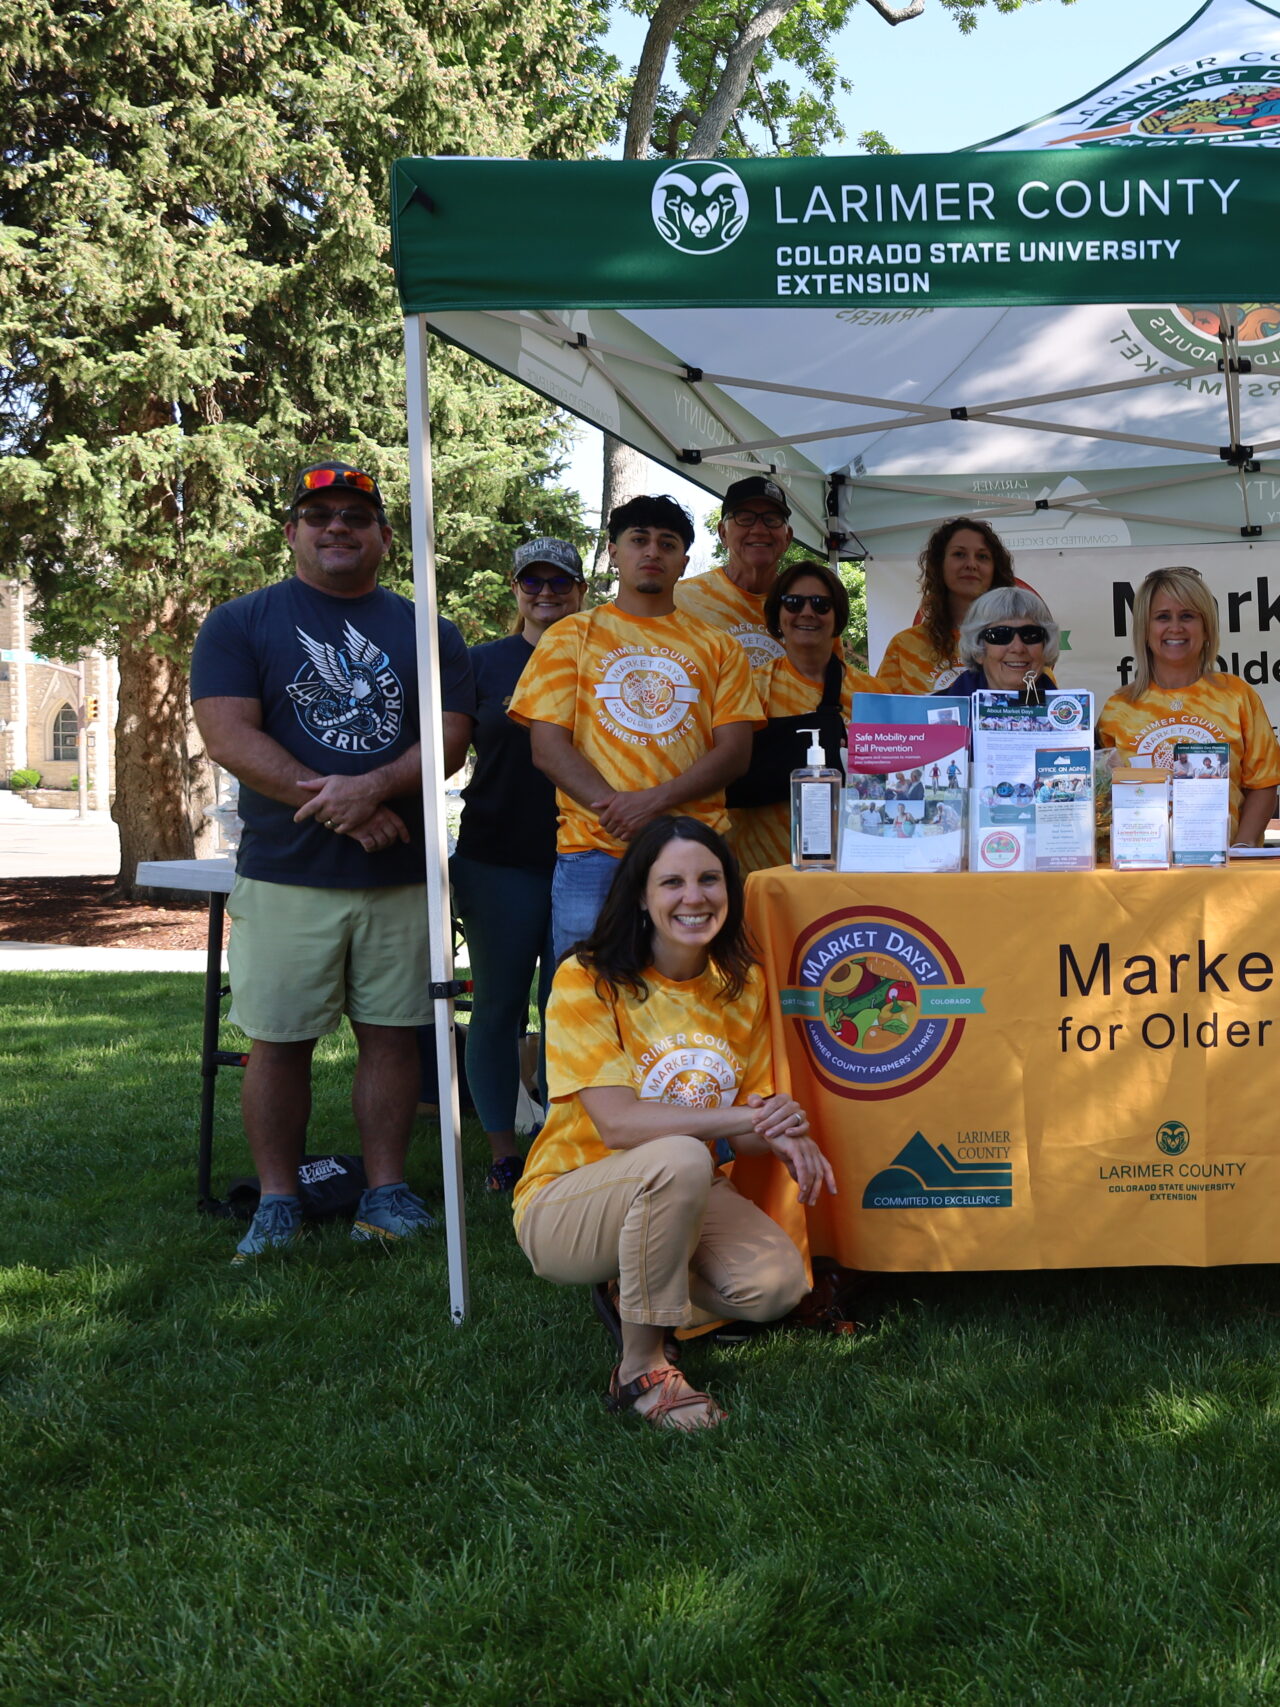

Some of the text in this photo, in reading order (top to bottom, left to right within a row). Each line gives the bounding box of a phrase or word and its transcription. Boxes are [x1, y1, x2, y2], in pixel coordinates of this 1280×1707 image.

[1059, 56, 1217, 126] LARIMER
[1106, 69, 1248, 124] MARKET
[775, 177, 1242, 225] LARIMER COUNTY
[776, 238, 1182, 267] COLORADO STATE UNIVERSITY
[776, 271, 931, 296] EXTENSION
[595, 645, 700, 677] LARIMER COUNTY
[611, 659, 684, 682] MARKET DAYS
[321, 672, 400, 750] ERIC CHURCH
[612, 703, 626, 718] FOR
[656, 707, 682, 729] ADULTS
[595, 710, 697, 747] FARMERS' MARKET
[855, 732, 925, 744] Safe Mobility and
[1128, 715, 1226, 747] LARIMER COUNTY
[1143, 727, 1212, 751] MARKET DAYS
[855, 744, 913, 753] Fall Prevention
[802, 930, 939, 983] MARKET DAYS!
[930, 998, 971, 1006] COLORADO
[1058, 1017, 1123, 1053] for
[1141, 1012, 1273, 1050] Older
[633, 1032, 744, 1084] LARIMER COUNTY
[808, 1022, 936, 1074] LARIMER COUNTY FARMERS' MARKET
[648, 1054, 732, 1093] MARKET DAYS
[957, 1131, 1011, 1145] LARIMER
[957, 1146, 1011, 1160] COUNTY
[1099, 1162, 1247, 1180] LARIMER COUNTY
[873, 1195, 1001, 1207] COMMITTED TO EXCELLENCE
[1108, 1182, 1236, 1193] COLORADO STATE UNIVERSITY
[1149, 1192, 1197, 1202] EXTENSION
